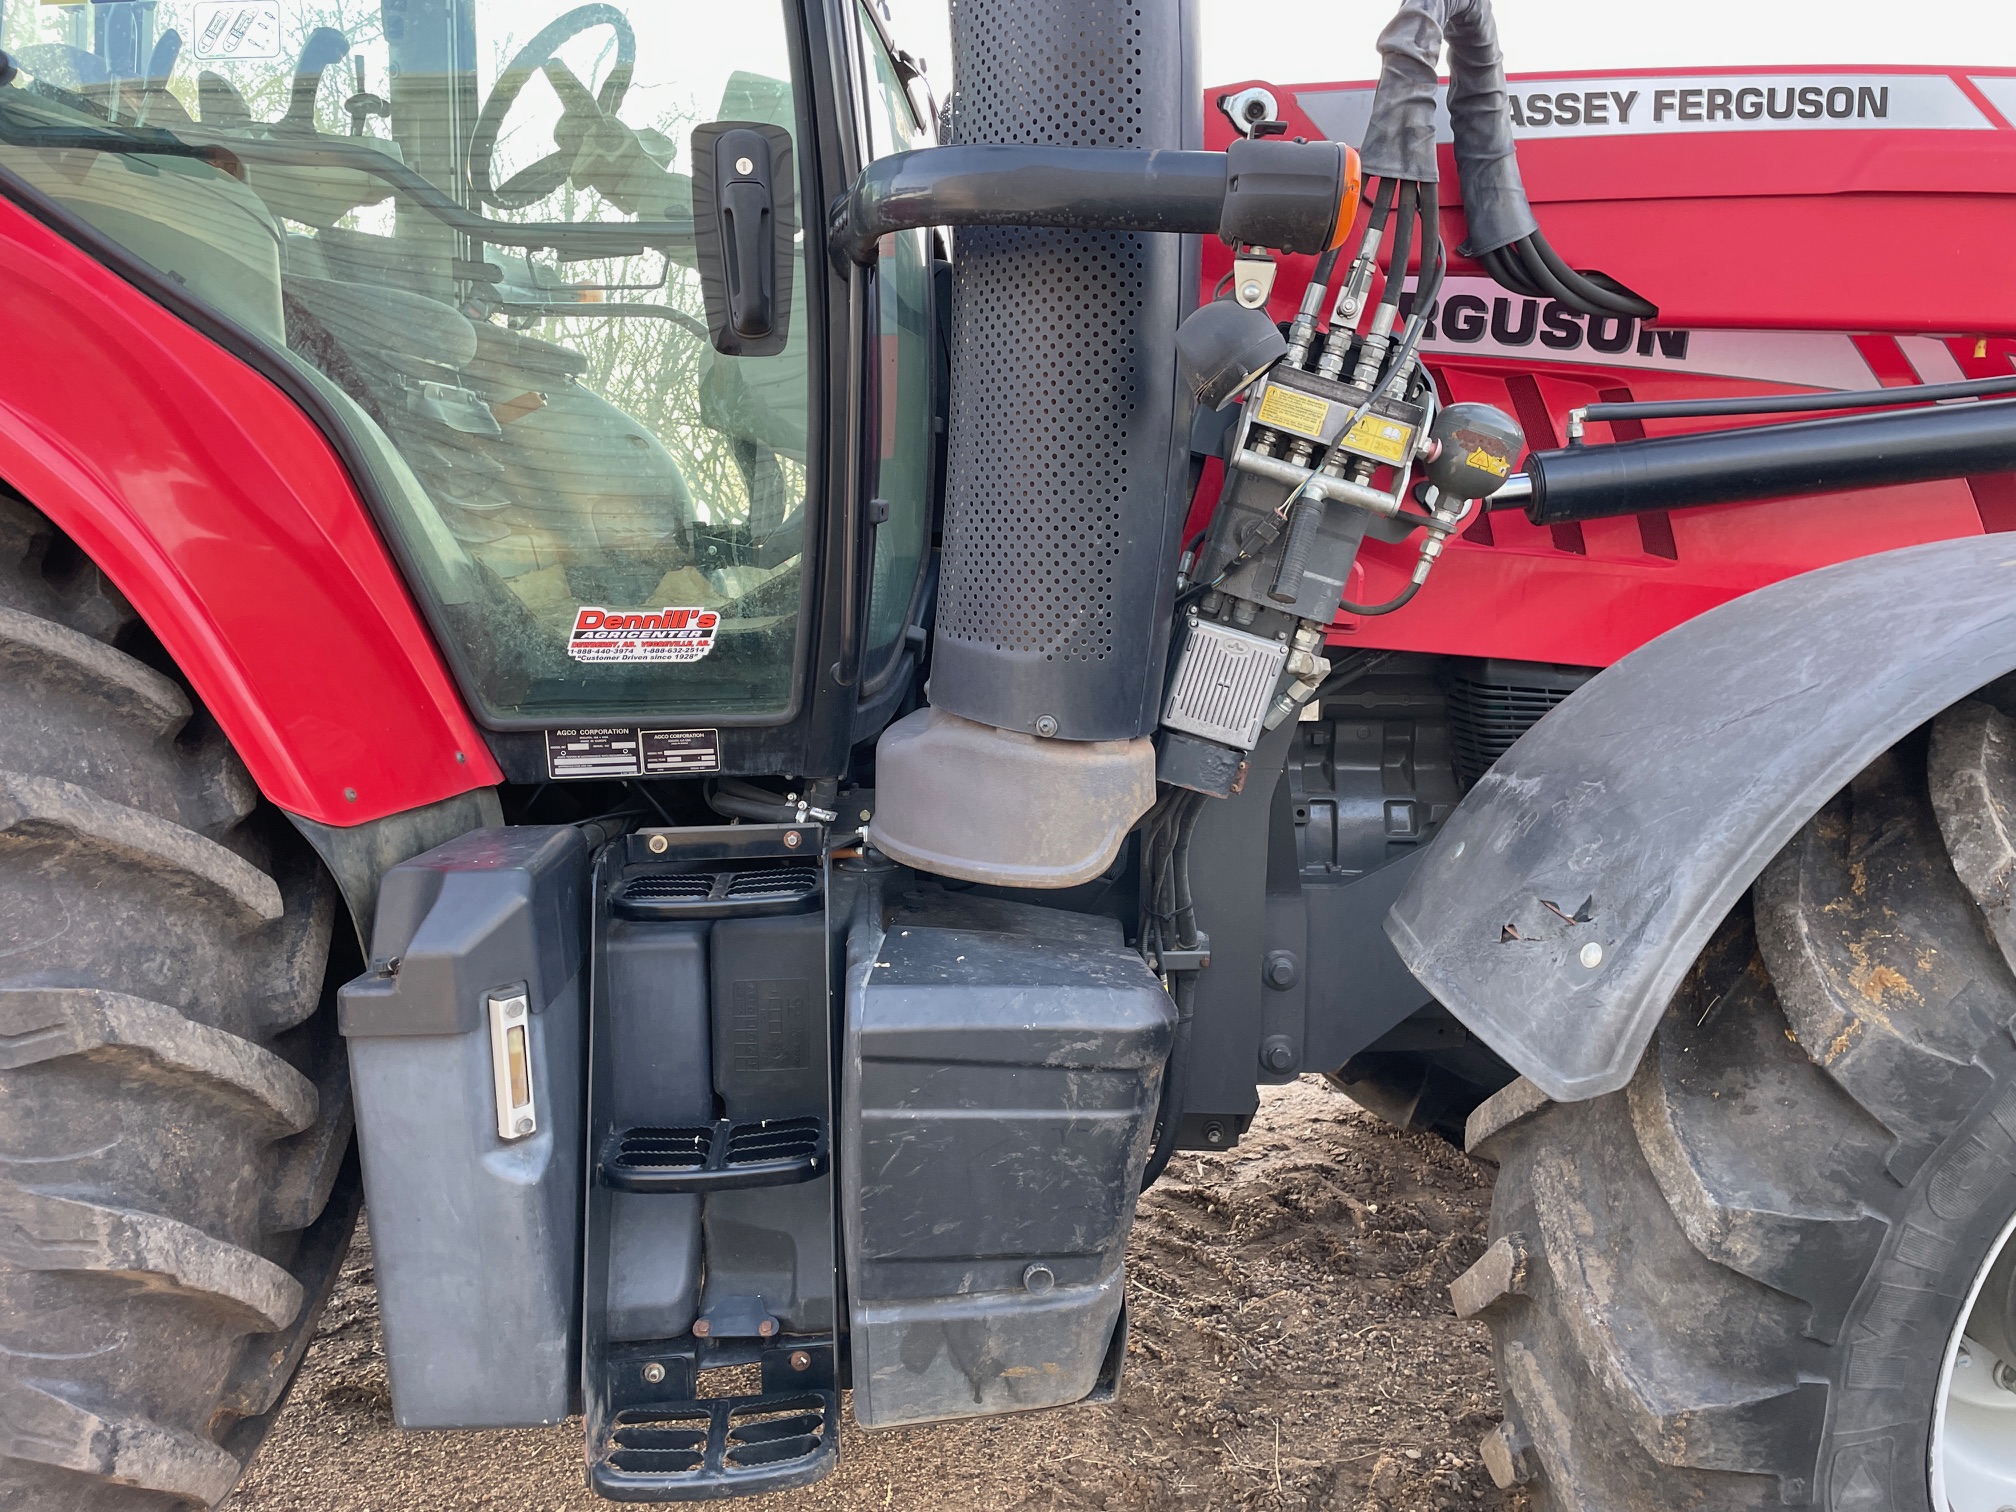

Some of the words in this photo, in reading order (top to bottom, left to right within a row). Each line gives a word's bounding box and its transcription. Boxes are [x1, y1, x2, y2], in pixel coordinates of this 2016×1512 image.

[1508, 90, 1640, 127] ASSEY
[1653, 86, 1890, 124] FERGUSON
[576, 610, 717, 630] Dennill's
[580, 630, 703, 639] AGRICENTER
[580, 728, 629, 736] CORPORATION
